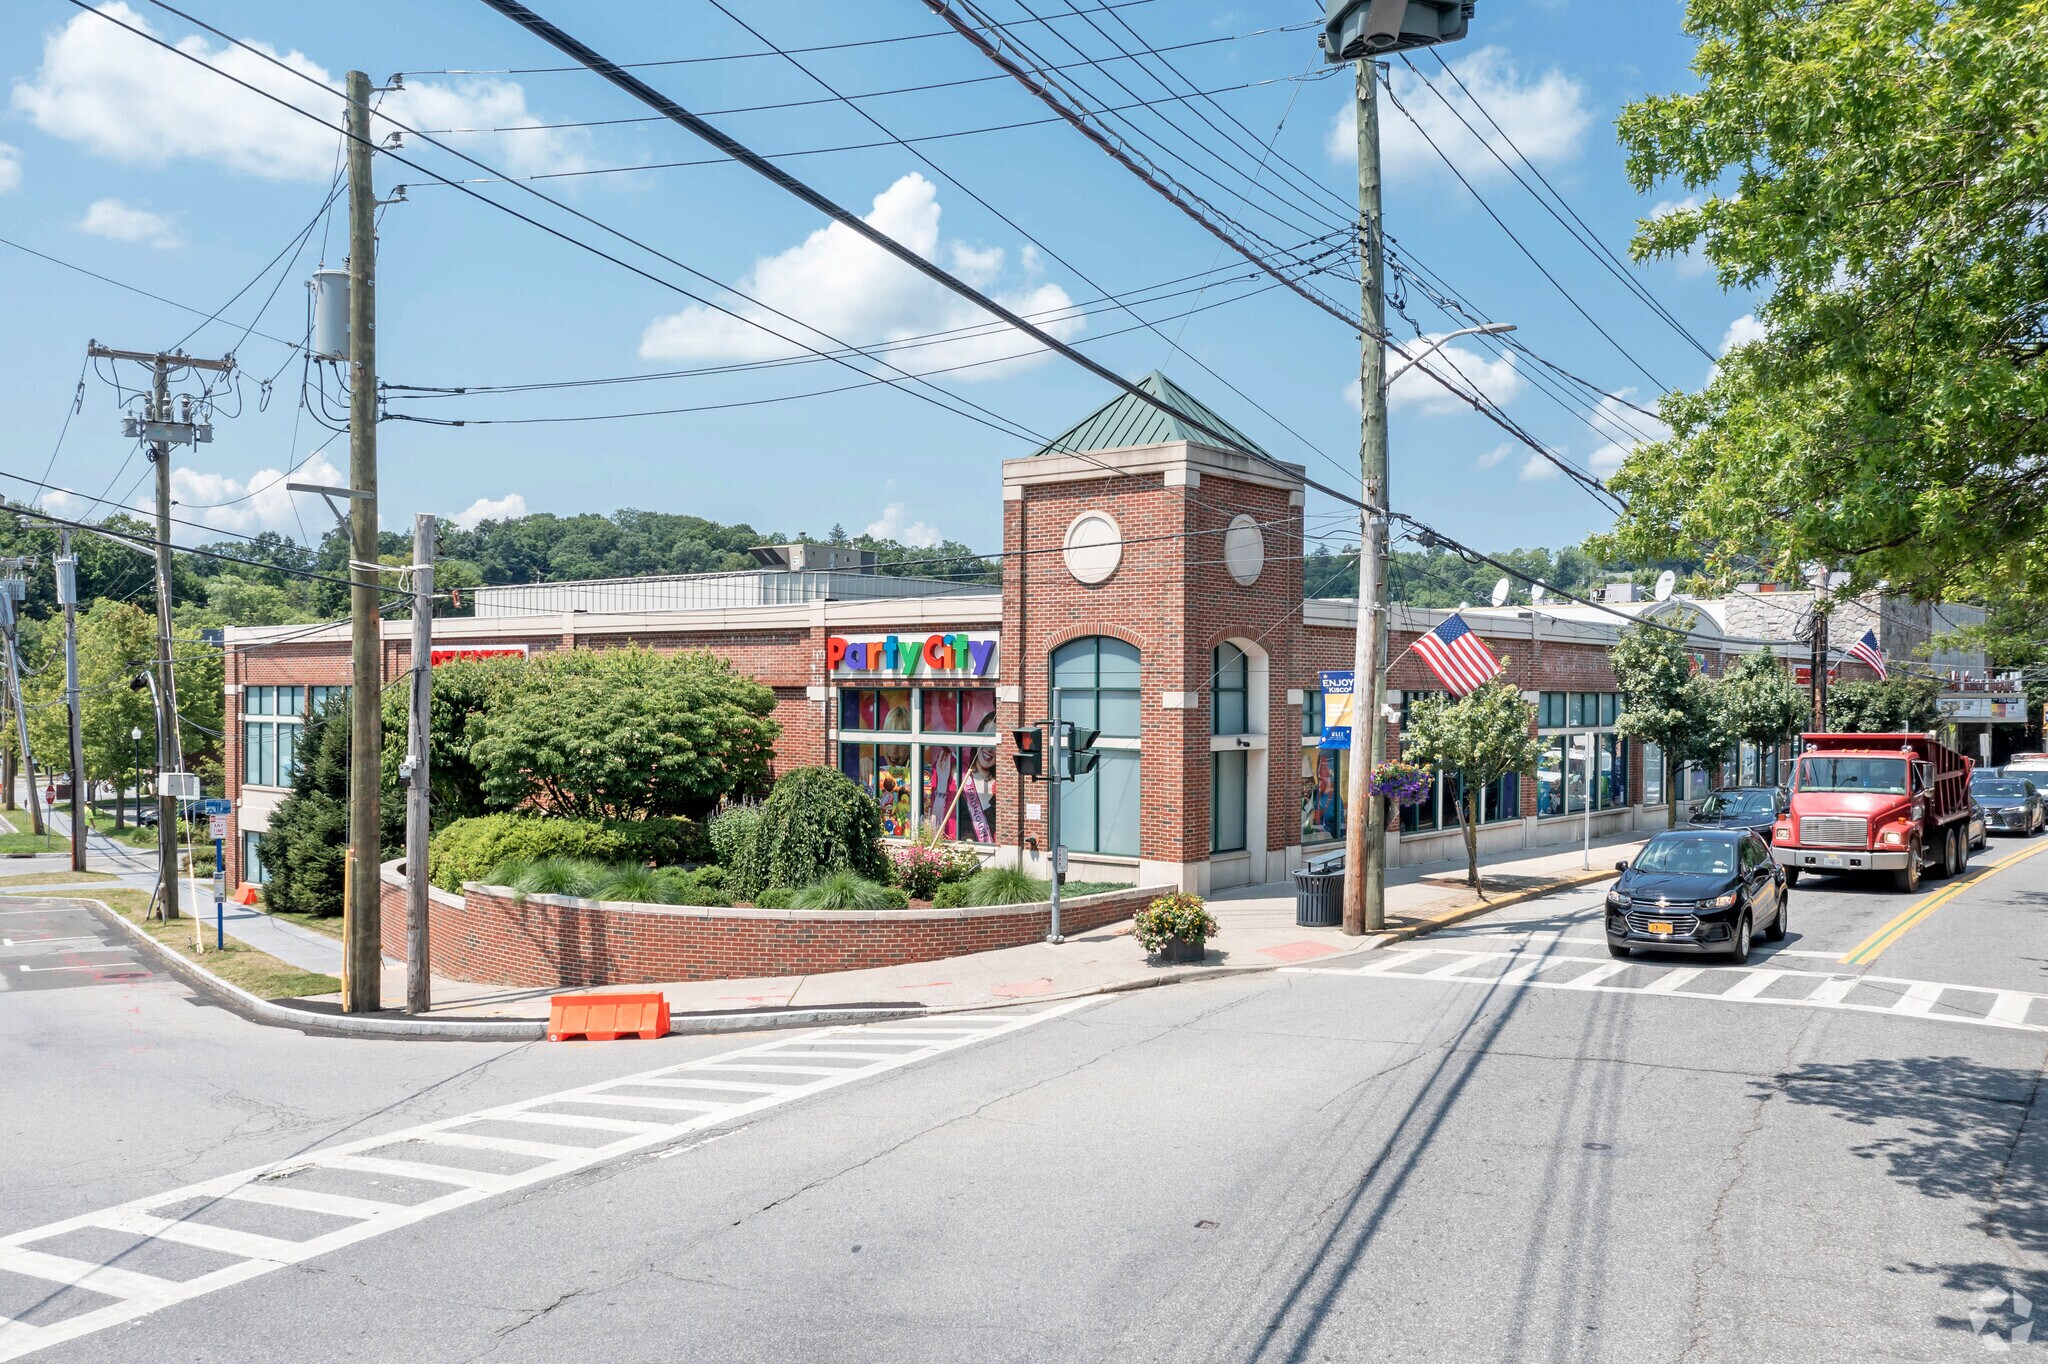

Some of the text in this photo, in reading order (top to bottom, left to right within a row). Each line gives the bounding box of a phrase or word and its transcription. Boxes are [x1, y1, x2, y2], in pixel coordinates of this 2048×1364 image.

[827, 634, 997, 676] Party City
[1322, 679, 1354, 687] ENJOY
